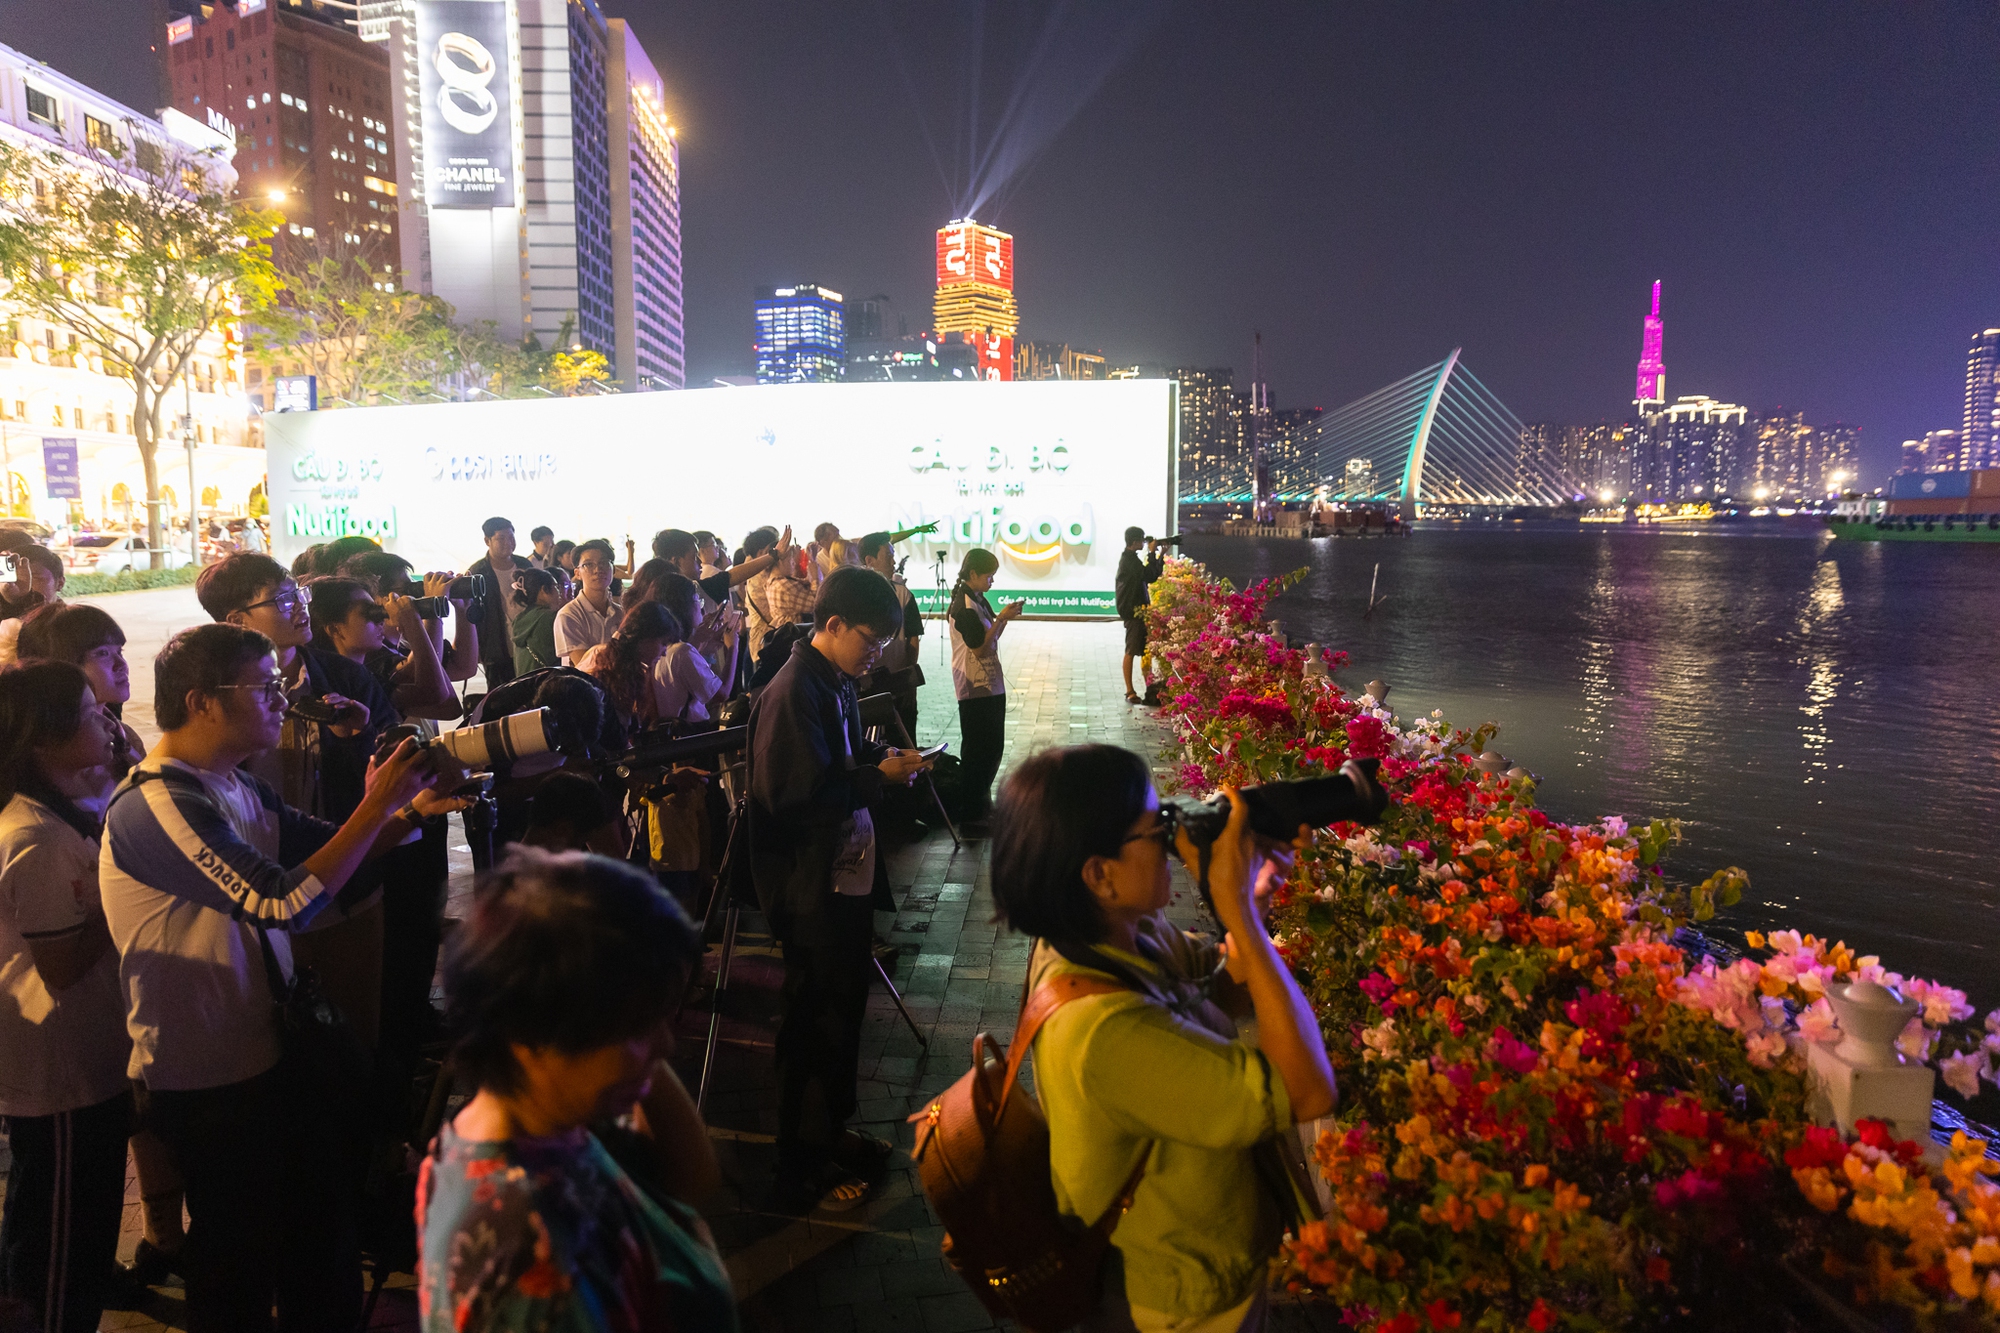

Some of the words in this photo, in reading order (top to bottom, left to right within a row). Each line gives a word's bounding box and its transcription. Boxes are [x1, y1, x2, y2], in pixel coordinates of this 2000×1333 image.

[433, 167, 505, 183] CHANEL
[284, 502, 398, 539] Nutifood
[889, 501, 1094, 545] Nutifood
[1080, 597, 1116, 607] Nutifood
